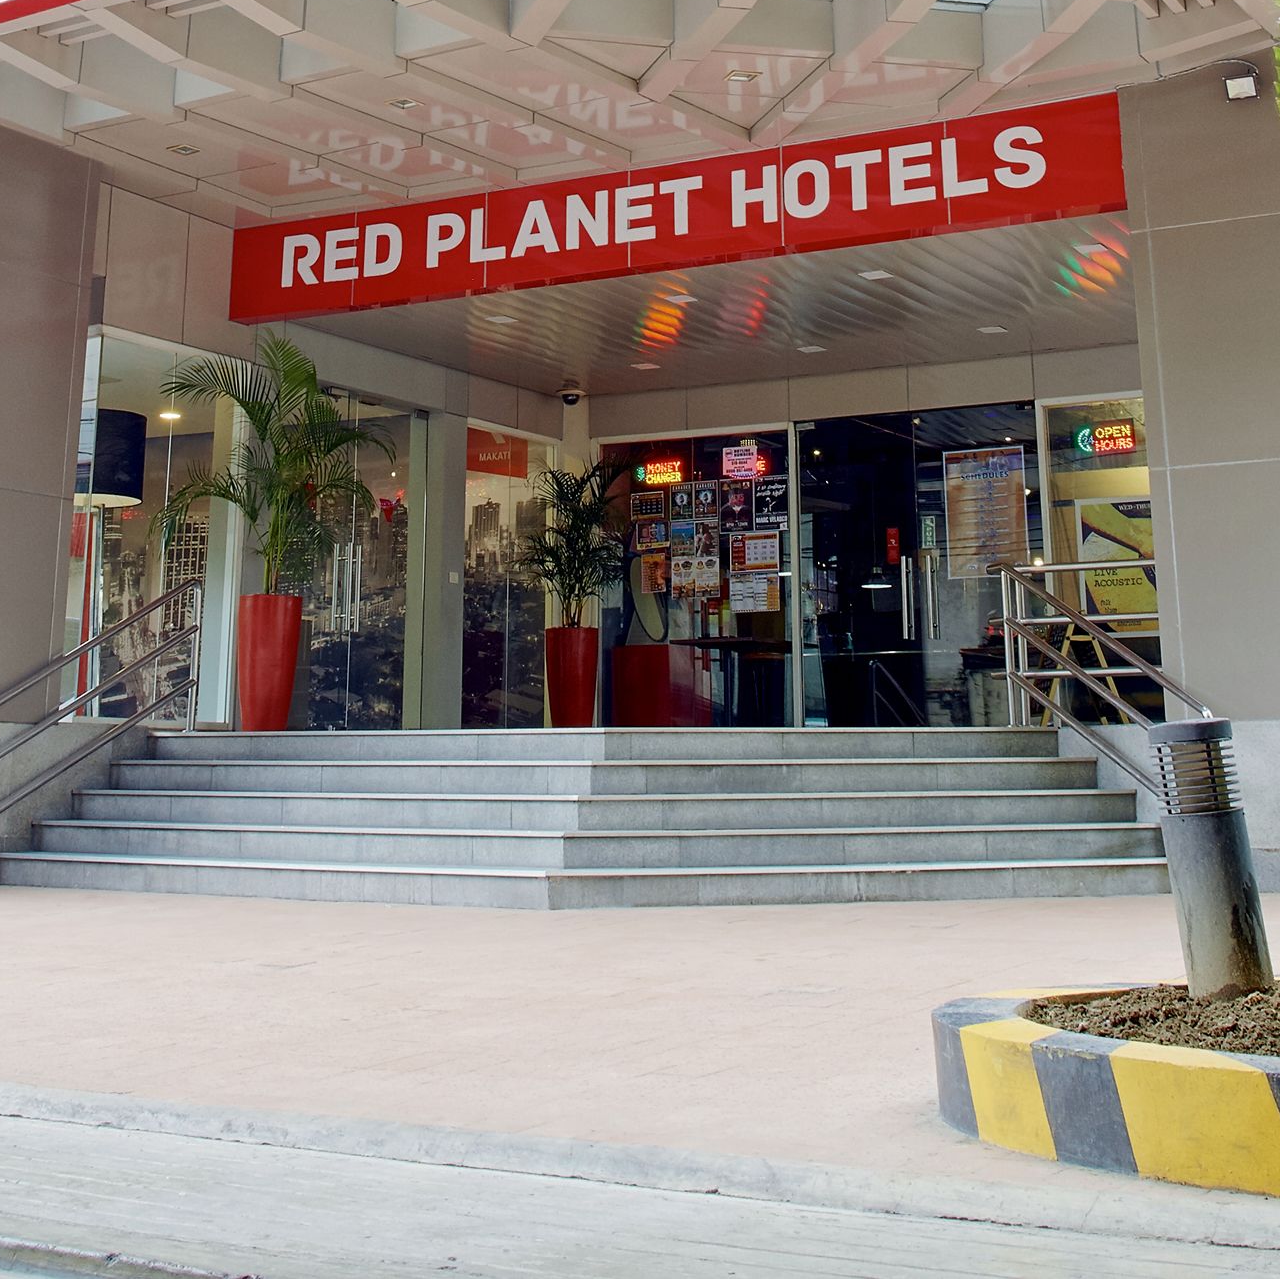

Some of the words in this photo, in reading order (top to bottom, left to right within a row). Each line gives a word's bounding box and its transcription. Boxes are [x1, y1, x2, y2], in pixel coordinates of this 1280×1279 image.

[281, 222, 403, 288] RED
[426, 176, 704, 269] PLANET
[731, 125, 1048, 227] HOTELS
[1095, 424, 1131, 438] OPEN
[1095, 437, 1133, 452] HOURS
[479, 451, 511, 462] MAKATI
[646, 461, 681, 473] MONEY
[645, 472, 682, 484] CHANGER
[960, 470, 1009, 481] SCHEDULES
[1094, 568, 1118, 577] LIVE
[1094, 577, 1143, 587] ACOUSTIC
